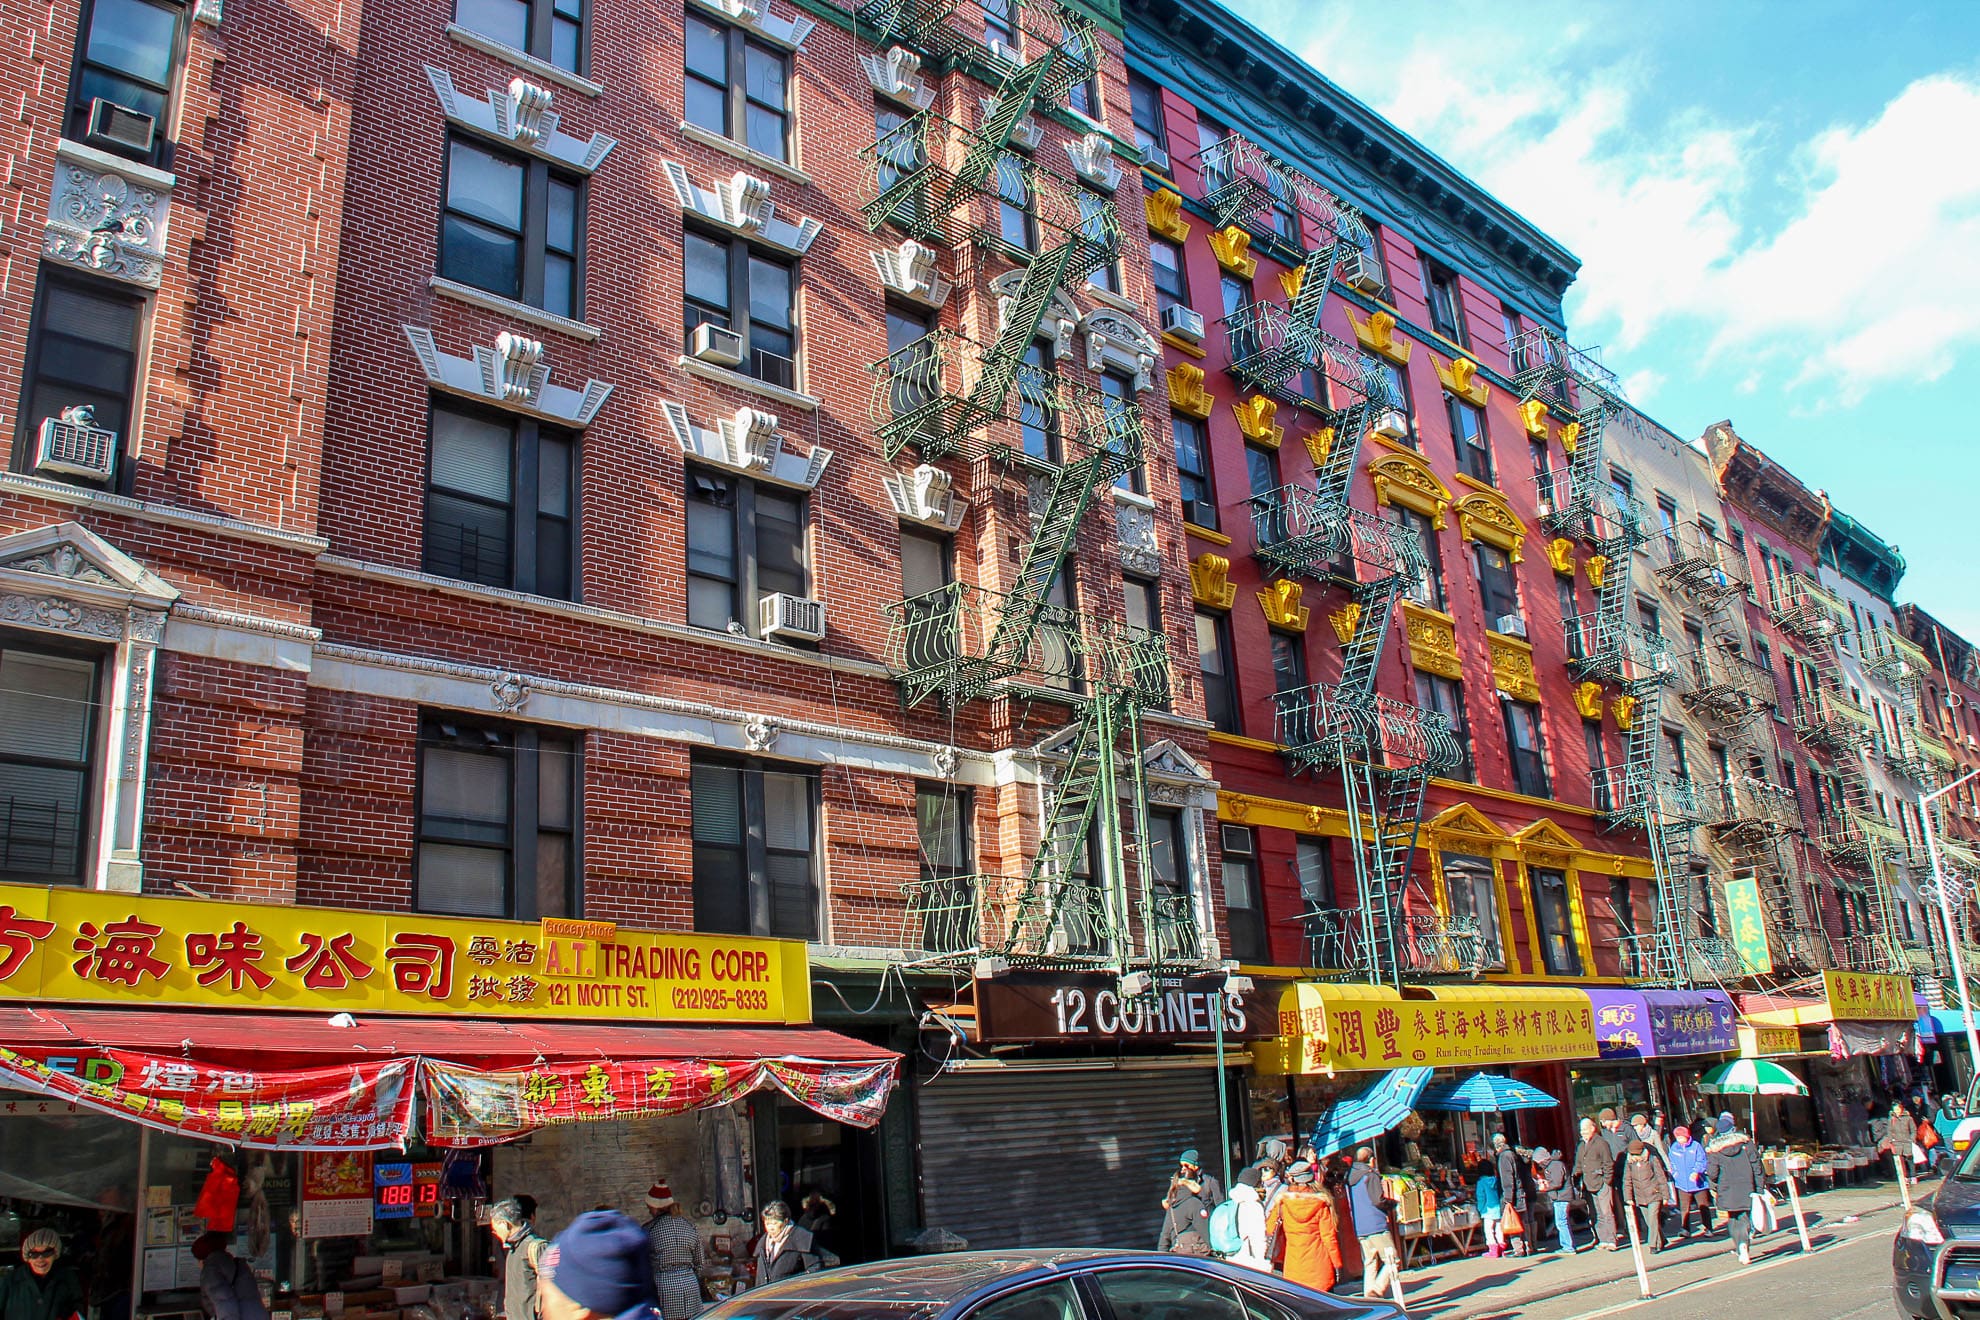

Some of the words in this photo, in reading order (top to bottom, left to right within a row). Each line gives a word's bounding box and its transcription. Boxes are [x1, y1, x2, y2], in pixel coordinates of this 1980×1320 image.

[544, 920, 587, 938] Grocery
[587, 922, 615, 937] Store
[467, 935, 537, 966] 零沽
[545, 940, 593, 975] A.T.
[600, 944, 700, 980] TRADING
[711, 949, 770, 982] CORP.
[467, 974, 539, 1002] 批發
[548, 983, 571, 1006] 121
[577, 983, 622, 1007] MOTT
[626, 985, 649, 1008] ST.
[672, 986, 768, 1010] (212)925-8333
[1050, 988, 1089, 1034] 12
[1332, 1007, 1402, 1061] 潤豐
[1435, 1046, 1451, 1058] Run
[1454, 1046, 1472, 1059] Feng
[1474, 1044, 1501, 1057] Trading
[1503, 1044, 1516, 1055] Inc.
[382, 1185, 411, 1205] 188
[420, 1184, 437, 1202] 13
